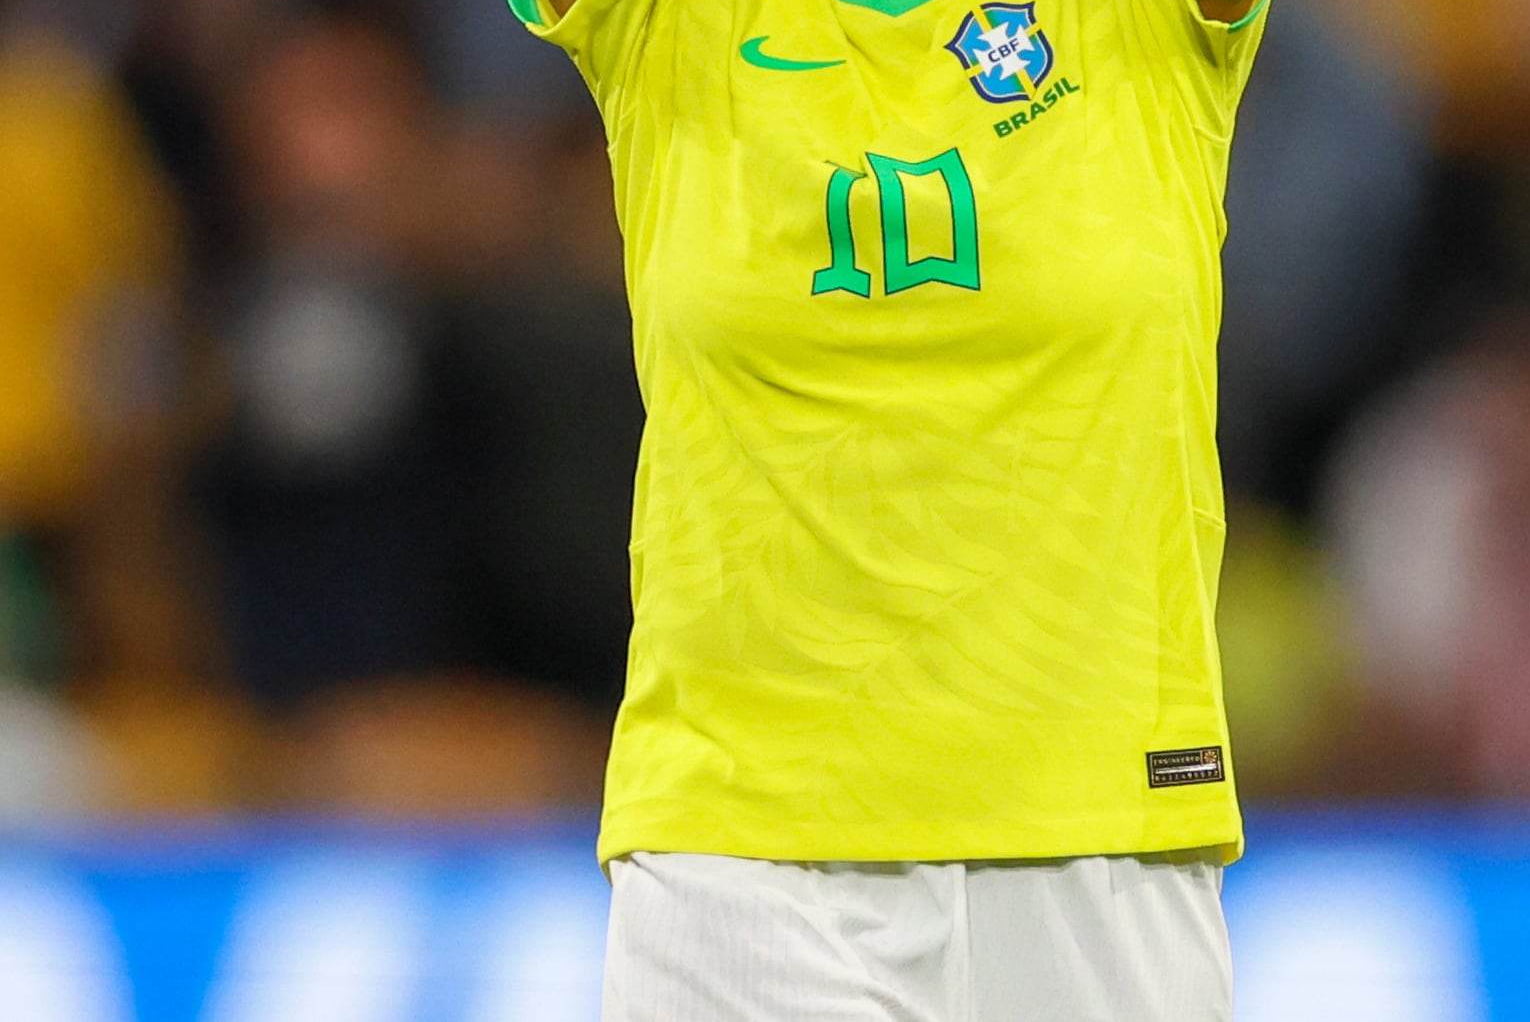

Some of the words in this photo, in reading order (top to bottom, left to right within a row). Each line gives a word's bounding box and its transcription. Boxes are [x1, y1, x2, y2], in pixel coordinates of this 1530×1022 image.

[988, 38, 1020, 63] CBF
[993, 77, 1080, 138] BRASIL
[811, 147, 981, 299] 10
